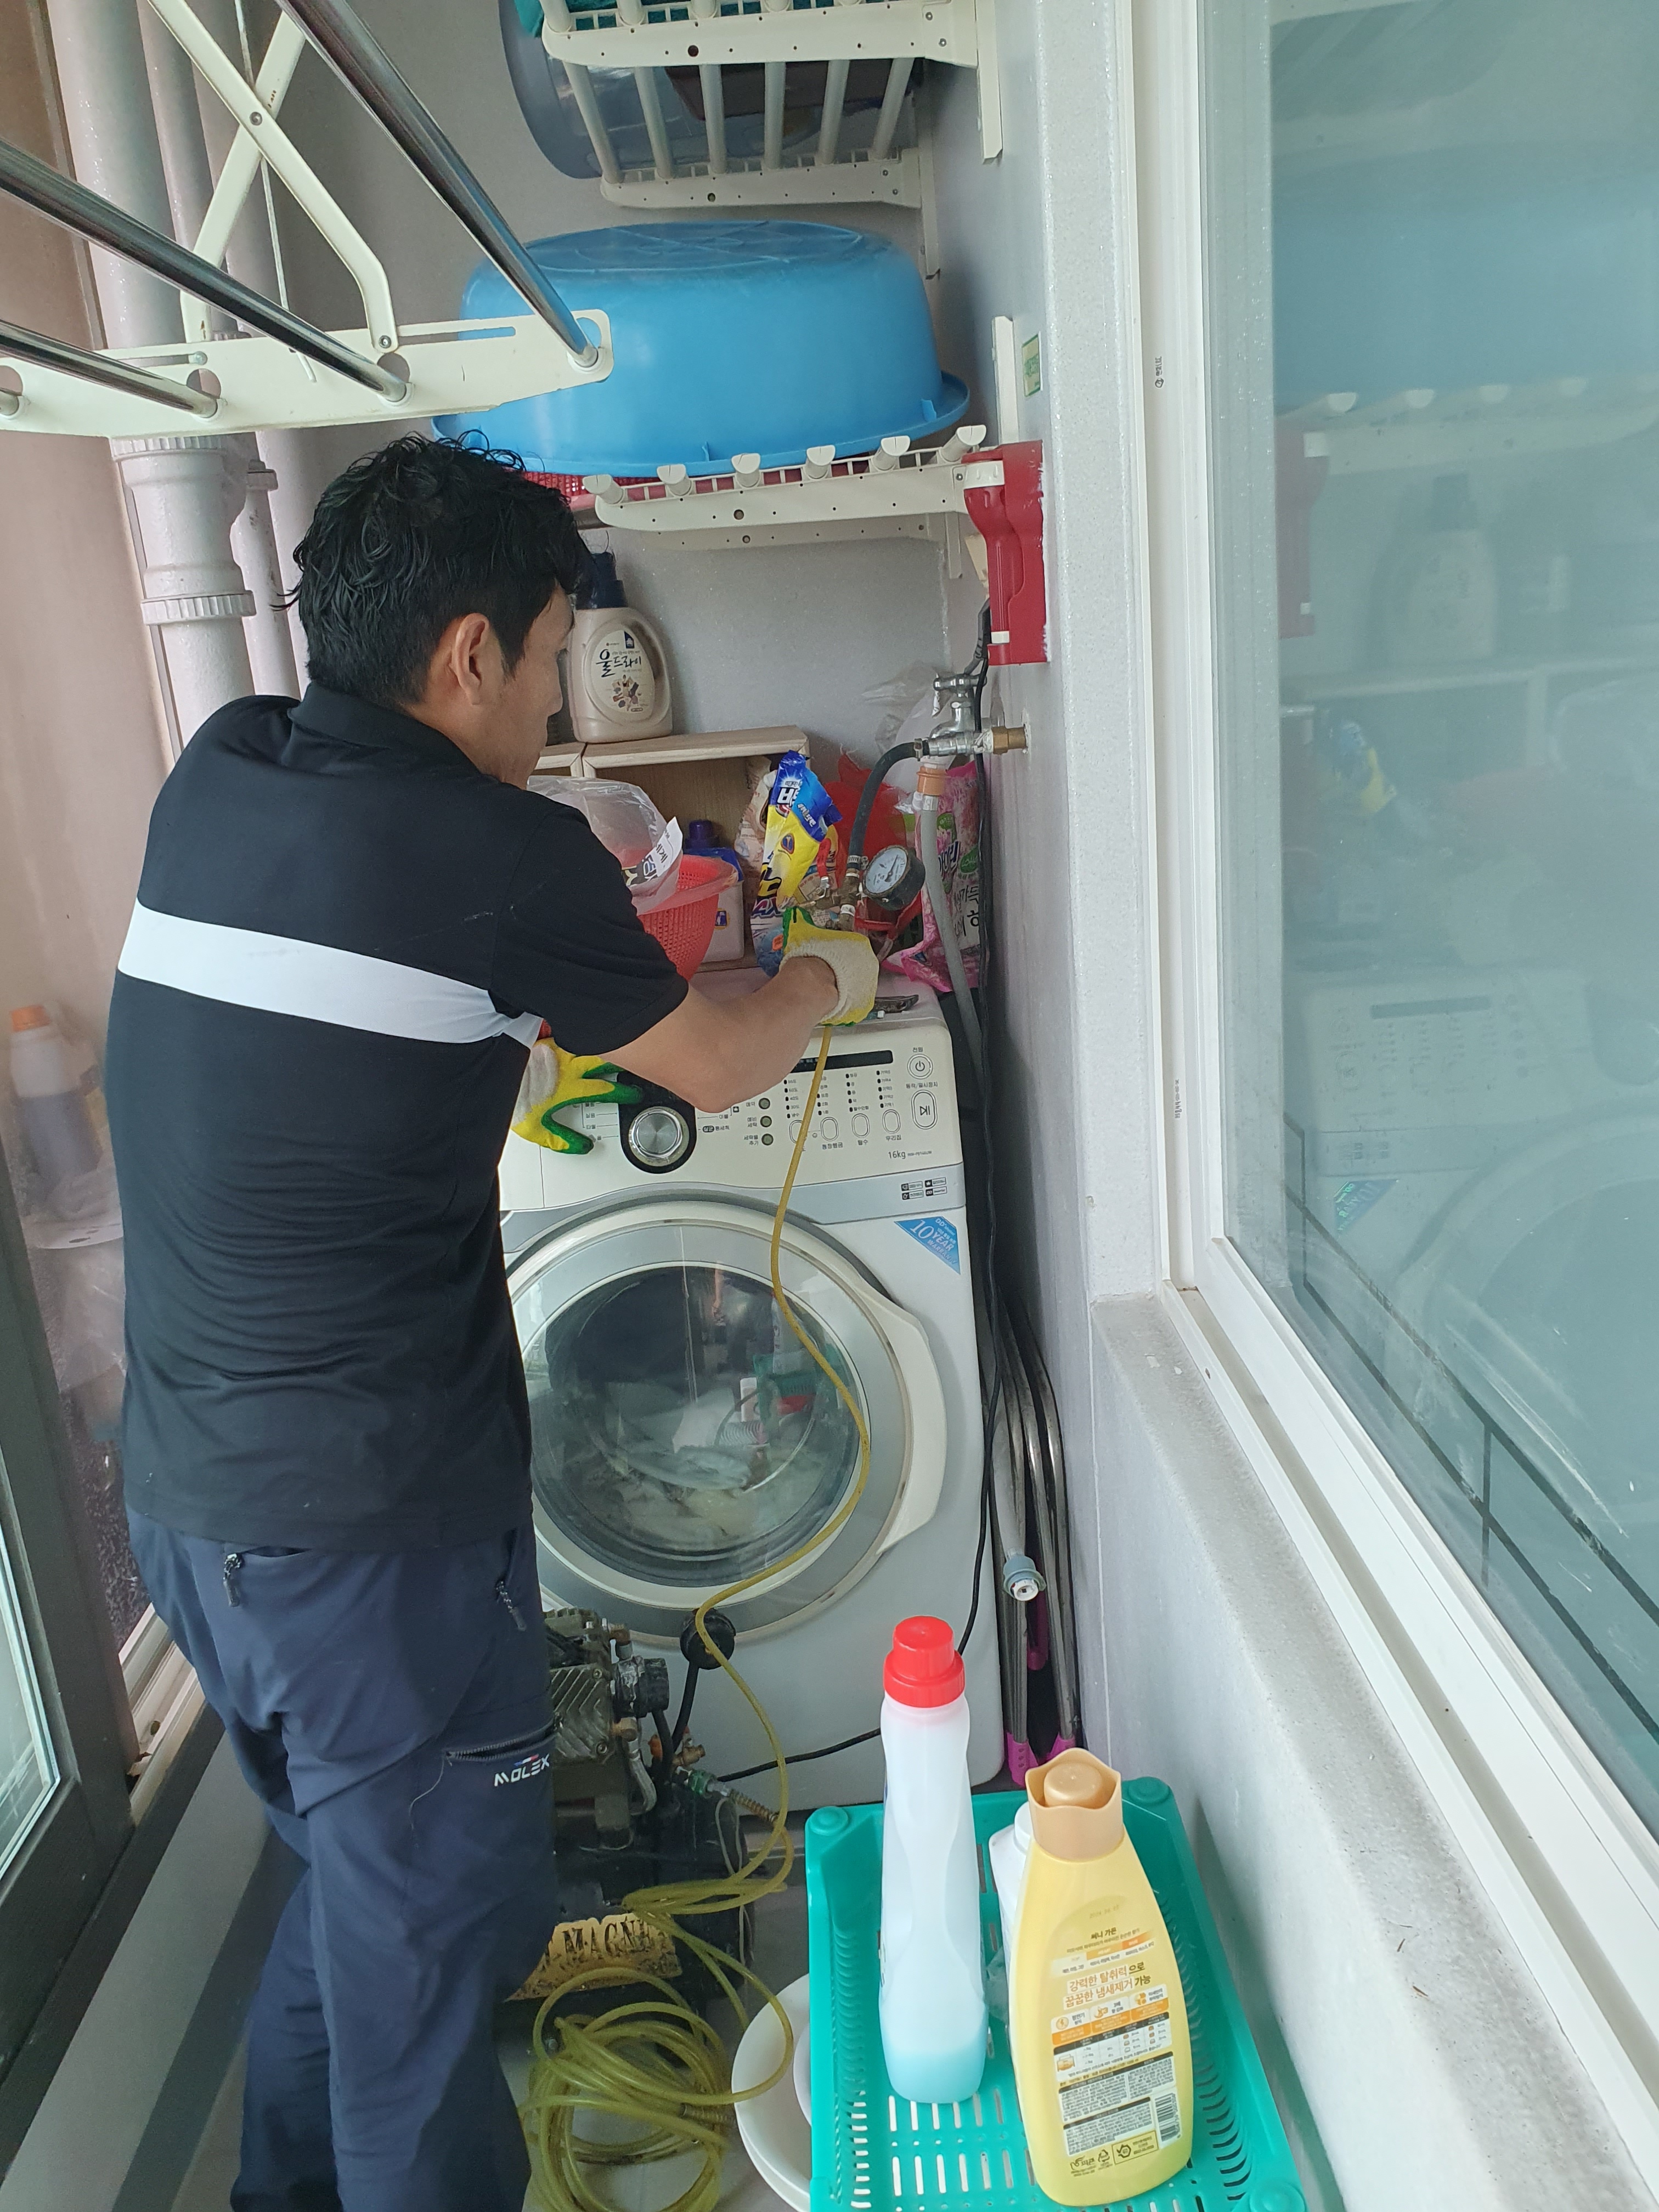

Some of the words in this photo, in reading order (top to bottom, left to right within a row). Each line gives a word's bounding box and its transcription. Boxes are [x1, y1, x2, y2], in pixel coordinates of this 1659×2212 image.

[596, 648, 641, 678] 울드라이
[888, 1150, 906, 1159] 16kg
[910, 1220, 934, 1239] 10
[933, 1232, 954, 1251] YEAR
[927, 1240, 957, 1265] WARRANTY
[494, 1753, 549, 1787] MOLEX
[1091, 1931, 1103, 1939] 써니
[1104, 1927, 1117, 1937] 가든
[1065, 1989, 1093, 2008] 꿉꿉한
[1096, 1978, 1133, 1999] 냄새제거
[1135, 1975, 1151, 1986] 가능
[1070, 1974, 1097, 1993] 강력한
